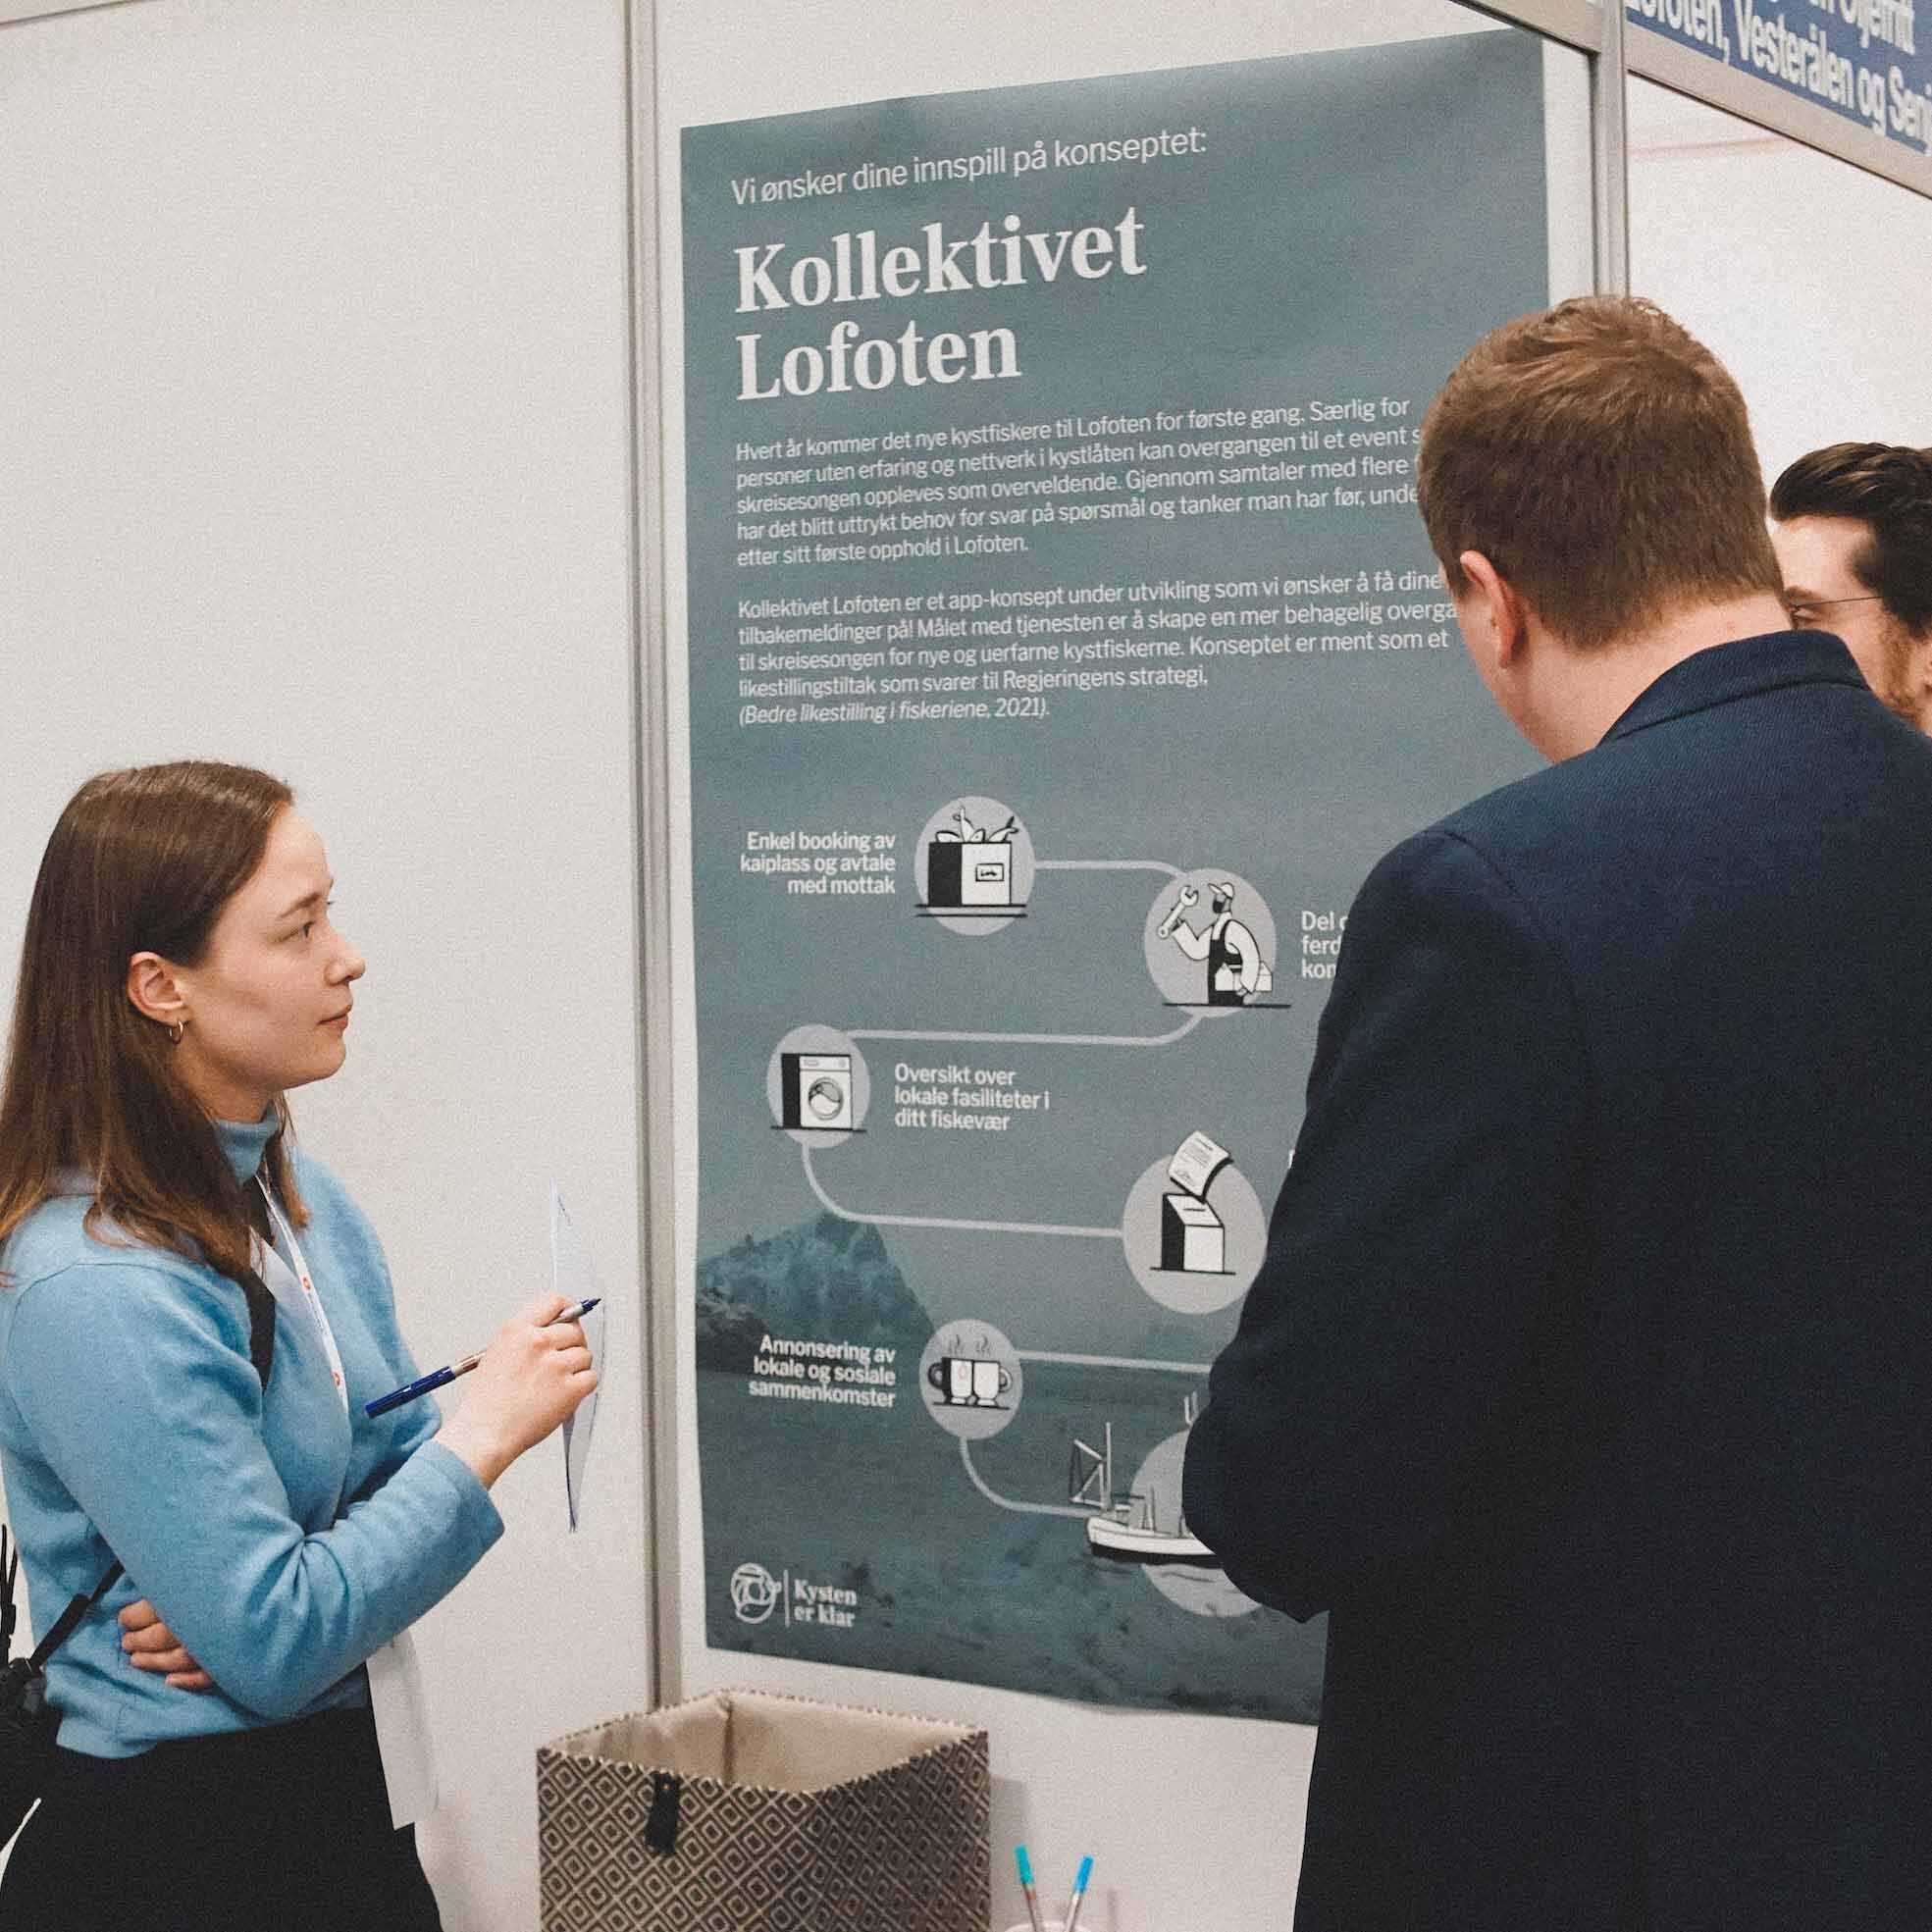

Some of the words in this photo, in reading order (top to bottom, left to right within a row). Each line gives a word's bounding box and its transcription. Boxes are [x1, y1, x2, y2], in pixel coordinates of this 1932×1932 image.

[1733, 0, 1854, 110] Vesterålen
[1857, 66, 1886, 135] og
[731, 178, 756, 204] Vi
[761, 171, 847, 201] ønsker
[853, 163, 908, 189] dine
[914, 146, 1006, 182] innspill
[1014, 139, 1047, 176] på
[1055, 126, 1207, 166] konseptet:
[733, 206, 1148, 314] Kollektivet
[735, 320, 1022, 401] Lofoten
[736, 442, 782, 460] Hvert
[786, 438, 803, 457] år
[807, 437, 878, 455] kommer
[882, 431, 912, 450] det
[915, 432, 948, 450] nye
[951, 424, 1052, 446] kystfiskere
[1055, 419, 1072, 438] til
[1077, 417, 1151, 436] Lofoten
[1156, 413, 1183, 430] for
[1187, 409, 1246, 428] første
[1250, 407, 1305, 428] gang.
[1309, 400, 1376, 422] Særlig
[1380, 398, 1410, 416] for
[738, 469, 812, 491] personer
[815, 464, 855, 482] uten
[859, 459, 928, 478] erfaring
[931, 458, 955, 476] og
[959, 450, 1036, 471] nettverk
[1139, 443, 1175, 459] kan
[1178, 437, 1296, 458] overgangen
[1300, 432, 1319, 449] til
[1323, 430, 1344, 449] et
[1349, 427, 1407, 446] event
[737, 493, 861, 513] skreisesongen
[864, 486, 944, 506] oppleves
[948, 484, 987, 499] som
[991, 475, 1122, 496] overveldende.
[1125, 470, 1215, 492] Gjennom
[1219, 463, 1306, 483] samtaler
[1311, 459, 1356, 478] med
[1362, 455, 1409, 475] flere
[737, 522, 765, 540] har
[768, 520, 798, 538] det
[801, 517, 834, 536] blitt
[838, 514, 897, 535] uttrykt
[901, 511, 956, 530] behov
[960, 507, 985, 526] for
[989, 508, 1027, 525] svar
[1032, 503, 1055, 525] på
[1059, 498, 1145, 522] spørsmål
[1149, 500, 1175, 519] og
[1178, 495, 1243, 514] tanker
[1248, 494, 1291, 510] man
[1296, 490, 1329, 508] har
[1333, 487, 1365, 506] før,
[783, 545, 810, 563] sitt
[814, 544, 866, 561] første
[868, 538, 941, 560] opphold
[954, 535, 1028, 554] Lofoten.
[739, 598, 829, 618] Kollektivet
[833, 596, 901, 614] Lofoten
[905, 596, 923, 611] er
[926, 593, 945, 610] et
[949, 589, 1065, 609] app-konsept
[1069, 585, 1124, 603] under
[1128, 581, 1211, 602] utvikling
[1215, 581, 1258, 598] som
[1262, 577, 1279, 596] vi
[1283, 576, 1352, 595] ønsker
[1356, 573, 1369, 593] å
[1374, 572, 1393, 591] få
[1398, 570, 1444, 590] dine
[739, 623, 883, 644] tilbakemeldinger
[917, 618, 966, 637] Målet
[971, 616, 1012, 635] med
[1017, 615, 1104, 637] tjenesten
[1108, 614, 1127, 630] er
[1131, 610, 1144, 630] å
[1148, 611, 1207, 630] skape
[1211, 610, 1235, 627] en
[1240, 609, 1279, 625] mer
[1284, 603, 1383, 625] behagelig
[739, 653, 755, 671] til
[758, 652, 884, 670] skreisesongen
[889, 647, 914, 665] for
[918, 650, 950, 667] nye
[954, 649, 976, 666] og
[981, 644, 1060, 662] uerfarne
[1064, 639, 1184, 661] kystfiskerne.
[1190, 635, 1291, 655] Konseptet
[1295, 637, 1317, 652] er
[1321, 632, 1374, 651] ment
[1379, 632, 1423, 650] som
[1428, 629, 1449, 649] et
[739, 676, 876, 698] likestillingstiltak
[880, 677, 919, 693] som
[922, 675, 978, 692] svarer
[982, 670, 999, 690] til
[1003, 669, 1125, 692] Regjeringens
[740, 705, 797, 724] (Bedre
[801, 703, 887, 723] likestilling
[994, 697, 1050, 717] 2021).
[747, 831, 796, 850] Enkel
[799, 831, 871, 852] booking
[874, 834, 896, 850] av
[741, 854, 810, 873] kaiplass
[813, 857, 838, 875] og
[840, 854, 896, 871] avtale
[788, 875, 827, 894] med
[830, 875, 895, 894] mottak
[1301, 910, 1334, 930] Del
[895, 1063, 970, 1083] Oversikt
[974, 1070, 1017, 1085] over
[895, 1086, 949, 1105] lokale
[952, 1088, 1041, 1109] fasiliteter
[895, 1107, 926, 1126] ditt
[930, 1109, 1011, 1130] fiskevær
[759, 1333, 871, 1364] Annonsering
[873, 1346, 896, 1363] av
[754, 1356, 805, 1377] lokale
[808, 1364, 830, 1384] og
[834, 1365, 896, 1385] sosiale
[749, 1382, 896, 1406] sammenkomster
[794, 1579, 857, 1605] Kysten
[794, 1606, 815, 1621] er
[818, 1604, 855, 1626] klar
